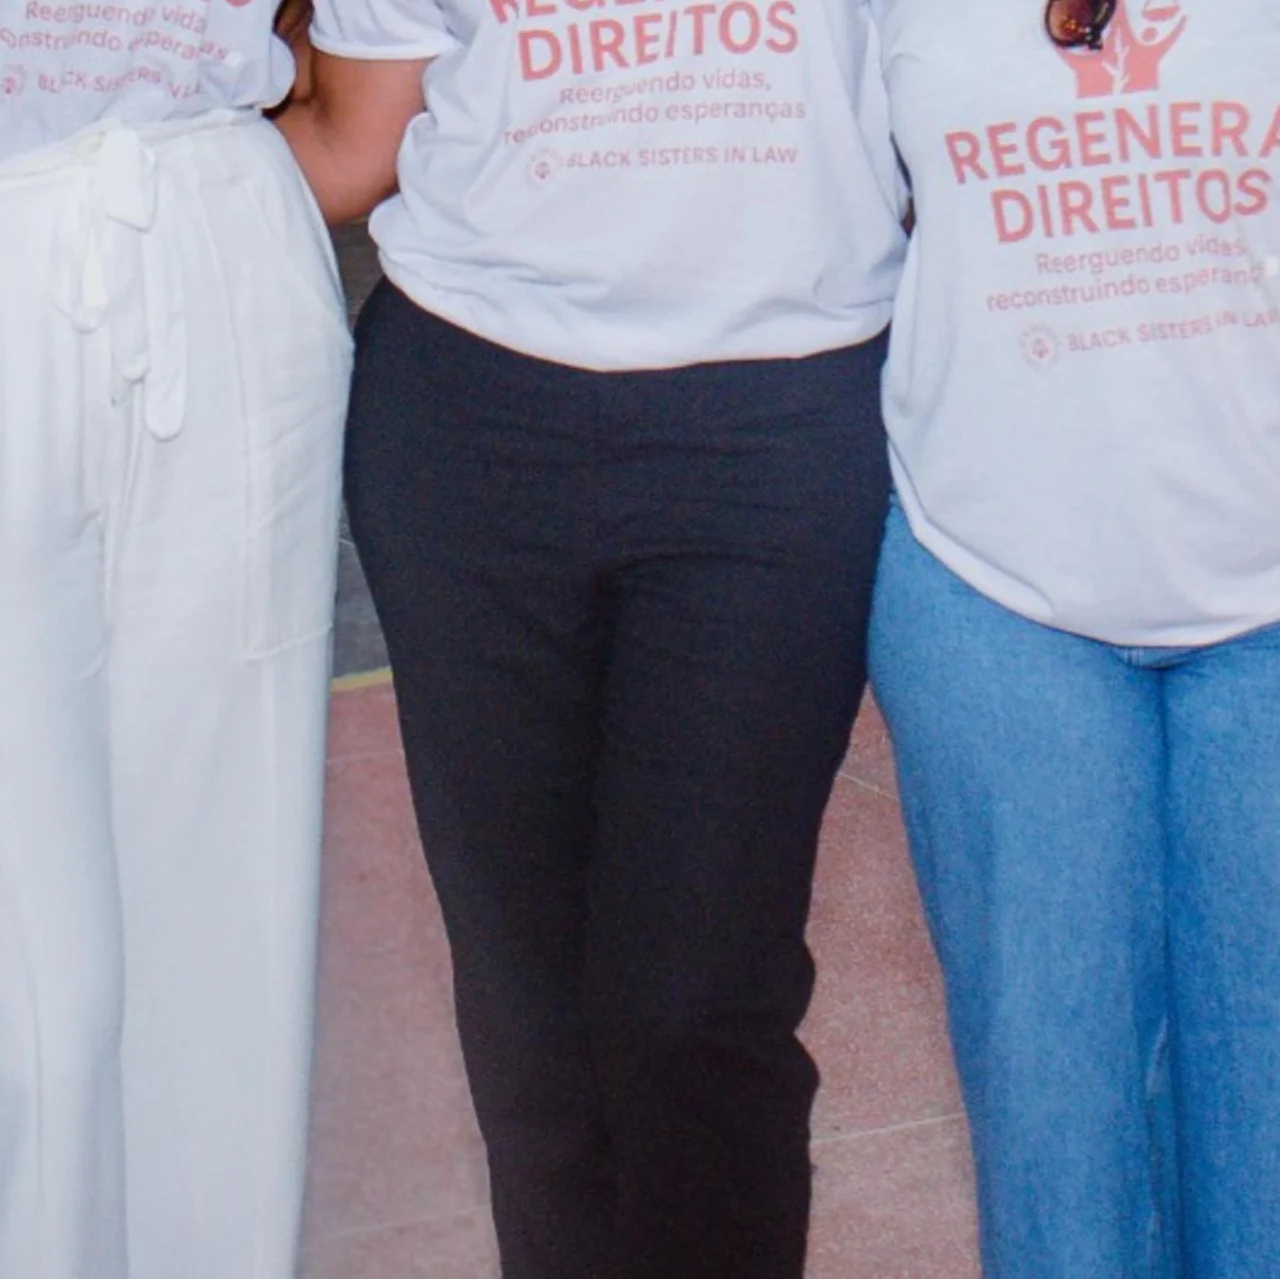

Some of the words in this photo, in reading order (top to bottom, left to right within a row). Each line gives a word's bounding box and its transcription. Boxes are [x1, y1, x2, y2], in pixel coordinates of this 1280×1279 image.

[25, 0, 155, 26] Reerguend
[517, 0, 799, 82] DIREITOS
[702, 68, 772, 91] vidas,
[665, 99, 807, 124] esperanças
[567, 150, 631, 169] BLACK
[638, 146, 718, 167] SISTERS
[724, 146, 745, 163] IN
[752, 145, 798, 164] LAW
[990, 167, 1272, 245] DIREITOS
[1036, 241, 1181, 275] Reerguendo
[986, 273, 1150, 312] reconstruindo
[1068, 327, 1131, 351] BLACK
[1136, 314, 1213, 341] SISTERS
